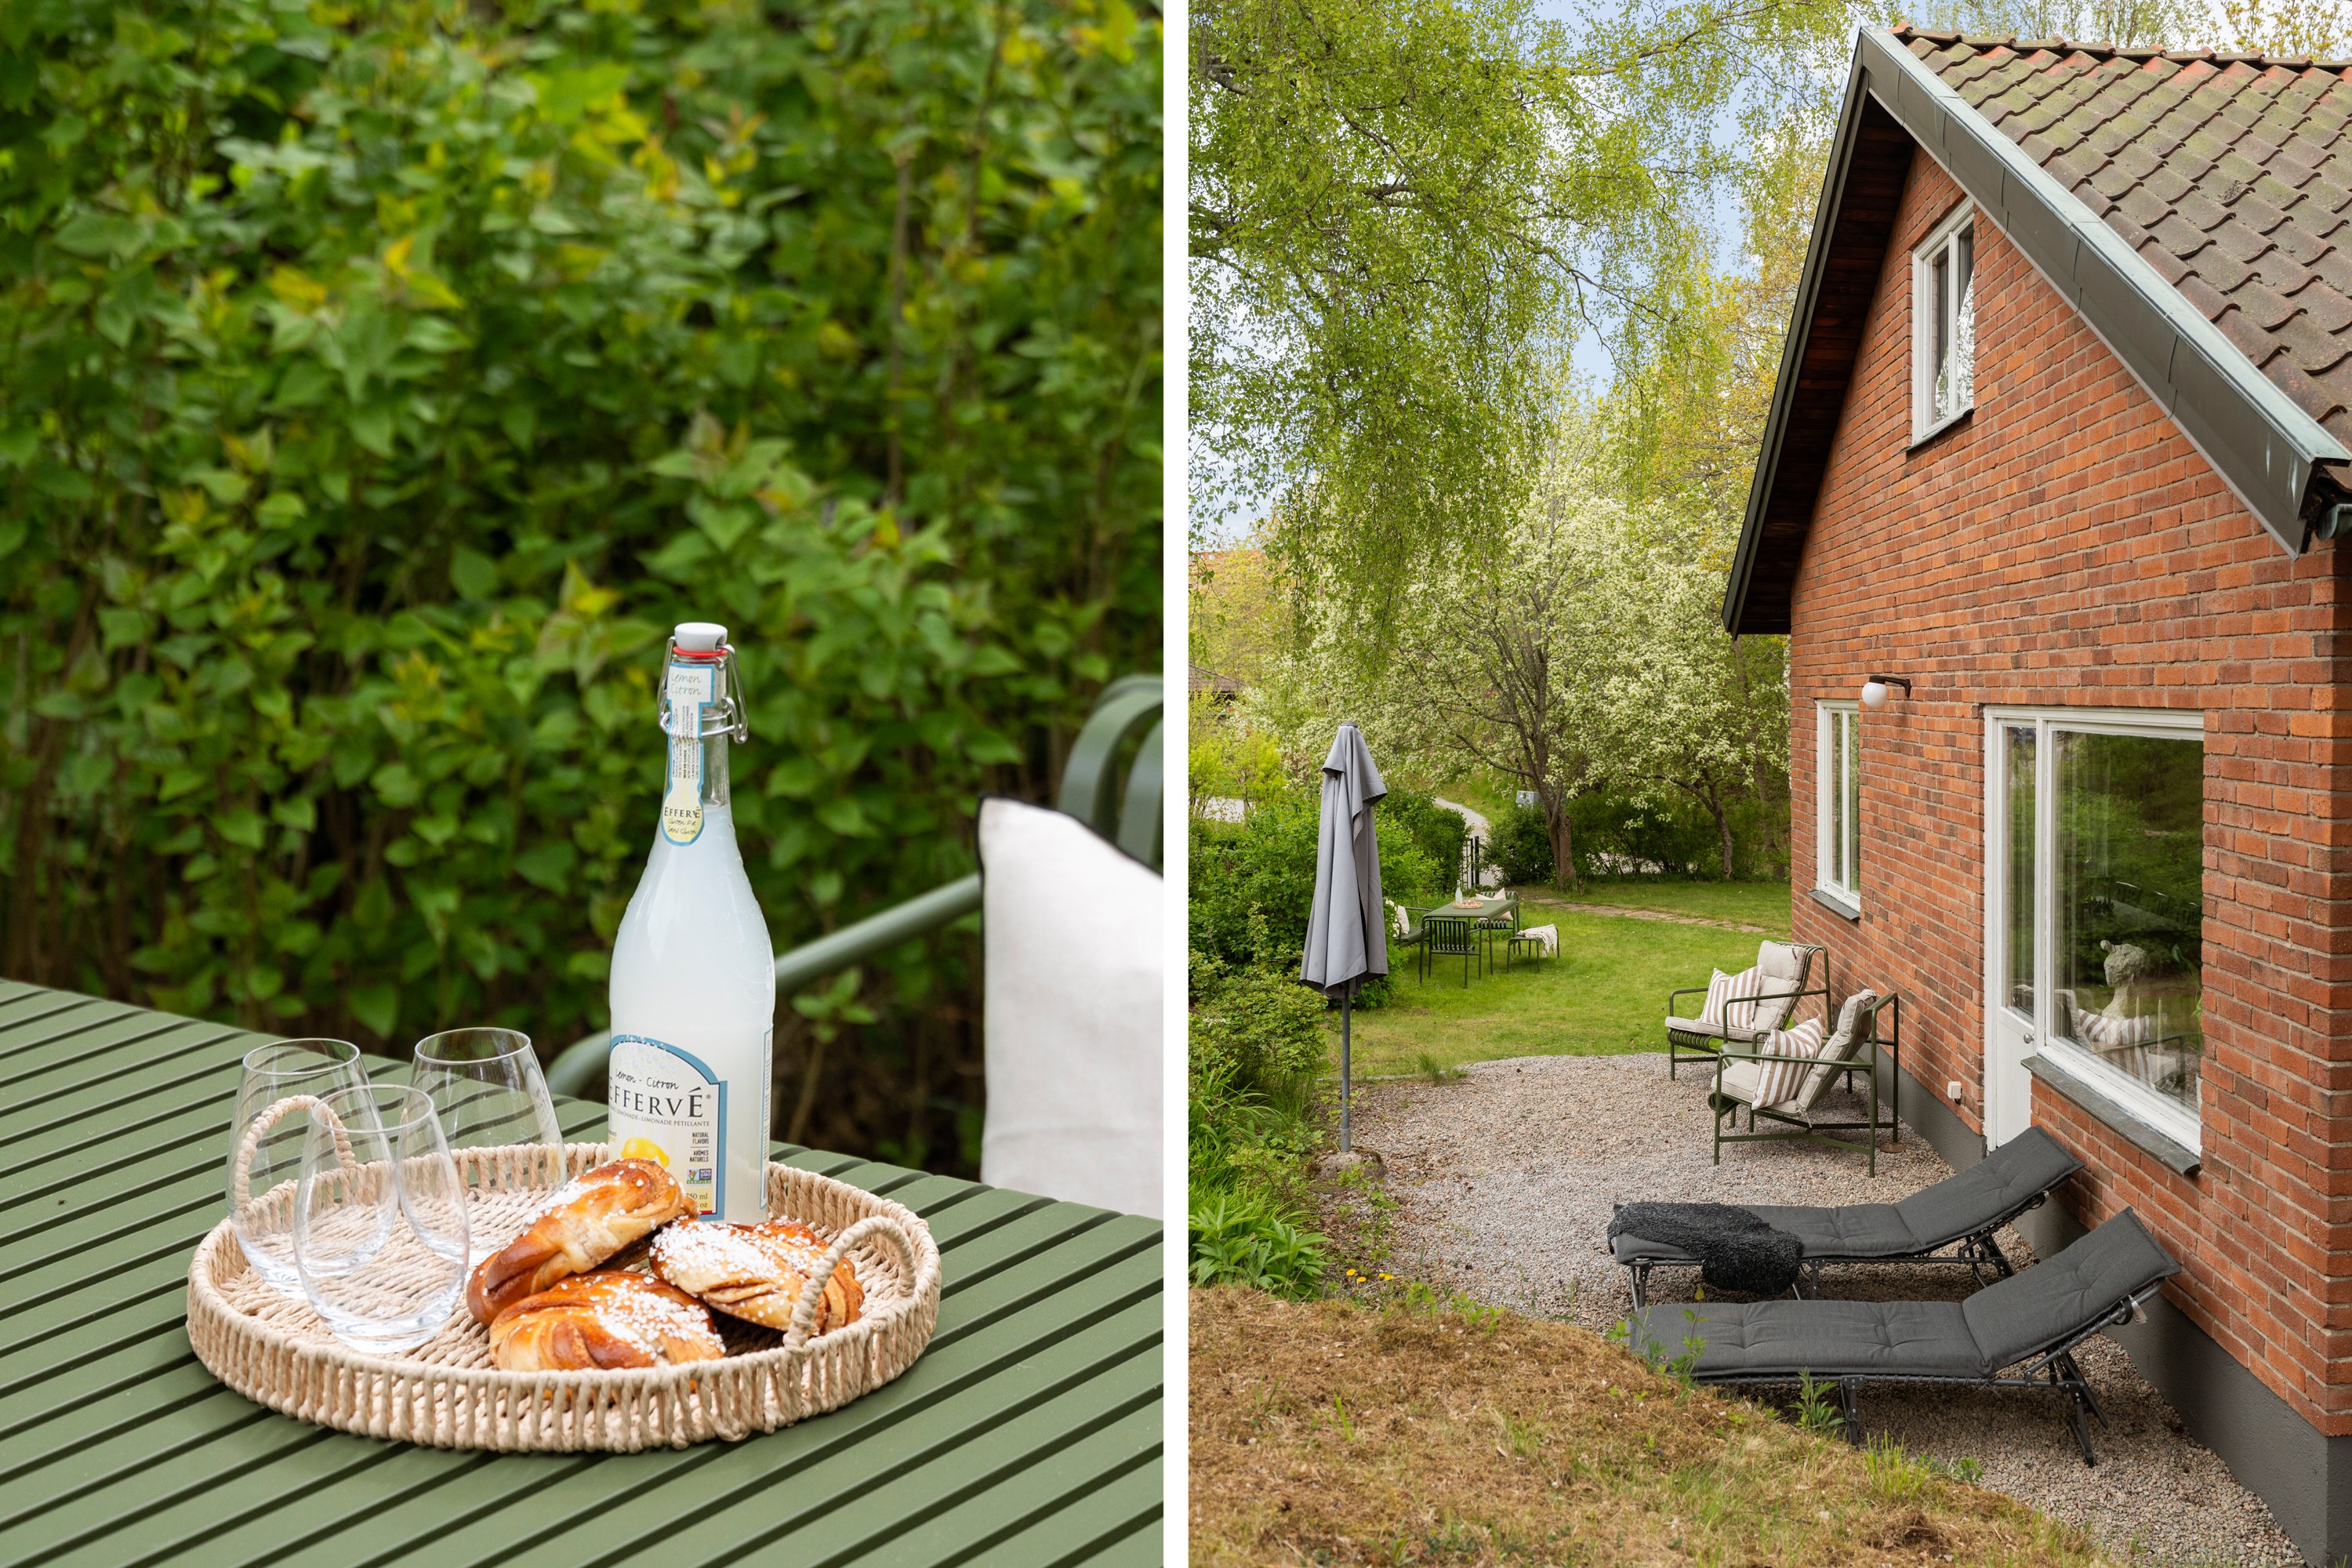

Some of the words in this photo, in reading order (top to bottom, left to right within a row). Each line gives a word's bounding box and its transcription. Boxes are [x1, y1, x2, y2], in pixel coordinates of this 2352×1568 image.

[671, 684, 702, 695] Citron
[615, 1068, 636, 1083] Lemon
[646, 1076, 679, 1090] Citron
[641, 1116, 673, 1127] LEMONADE
